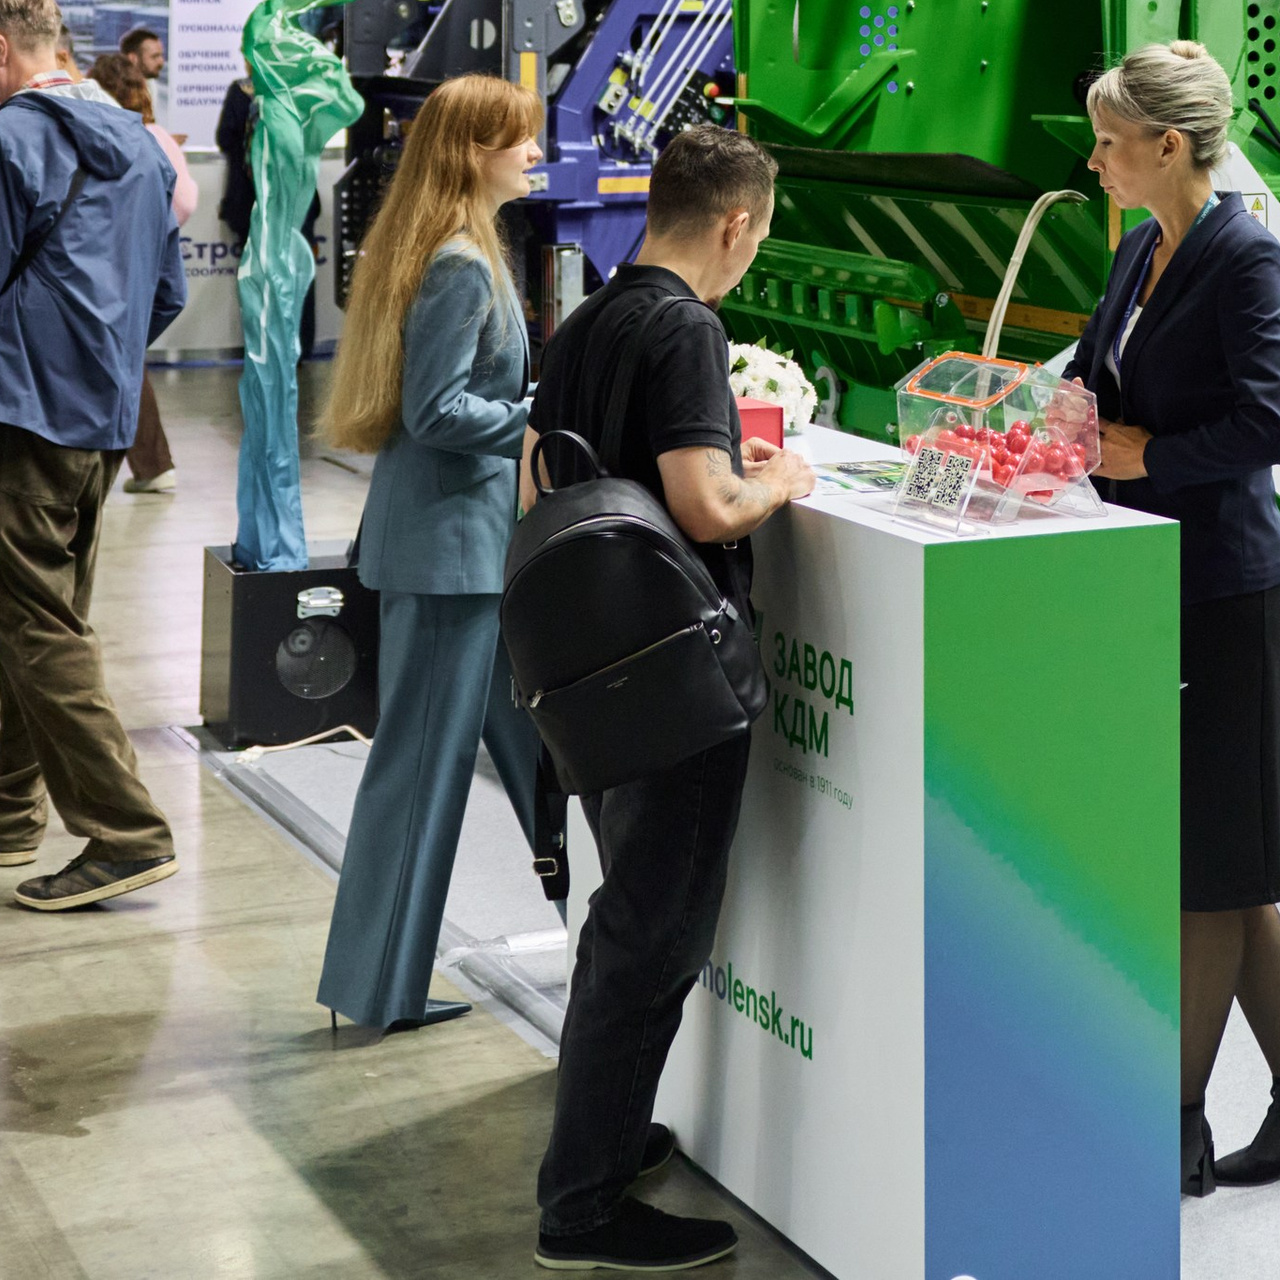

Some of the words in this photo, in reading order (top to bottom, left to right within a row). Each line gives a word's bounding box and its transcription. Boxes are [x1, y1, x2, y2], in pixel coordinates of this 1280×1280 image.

[178, 24, 243, 33] ПУСКОНАЛАД
[178, 50, 231, 59] ОБУЧЕНИЕ
[178, 64, 238, 72] ПЕРСОНАЛА
[177, 84, 226, 93] СЕРВИСНО
[177, 98, 223, 106] ОБСЛУЖ
[186, 267, 237, 277] СООРУЖ
[774, 631, 854, 716] ЗАВОД
[774, 689, 829, 758] КДМ
[773, 757, 808, 785] основан
[817, 775, 833, 794] 1911
[834, 785, 854, 810] году
[696, 960, 813, 1061] molensk.ru
